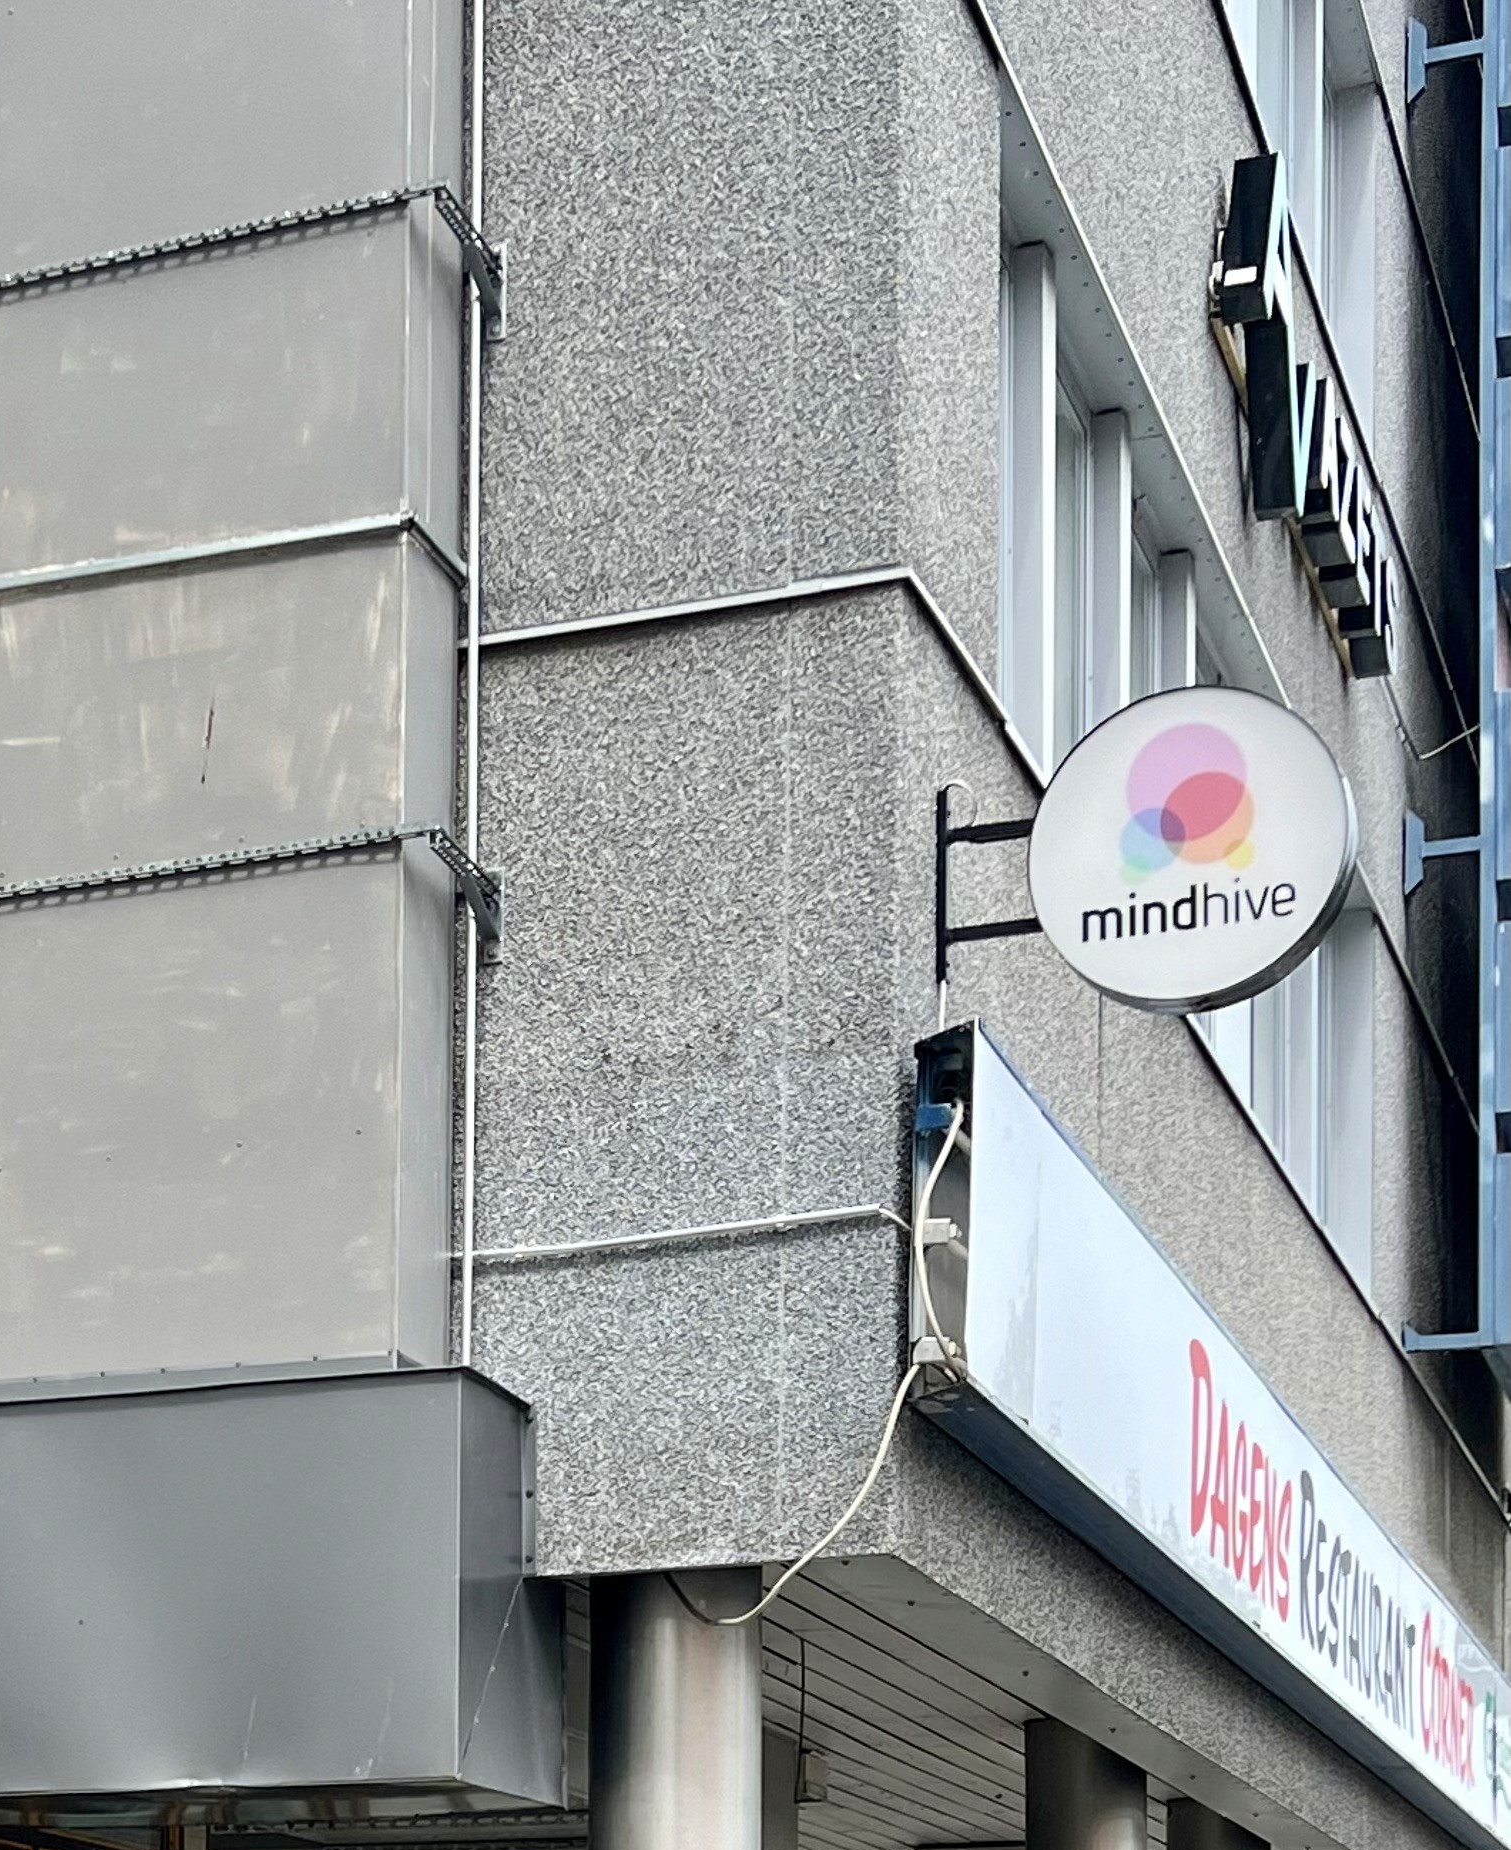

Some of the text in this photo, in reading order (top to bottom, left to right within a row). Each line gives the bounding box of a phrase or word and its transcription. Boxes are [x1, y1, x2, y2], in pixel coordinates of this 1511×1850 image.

[1082, 877, 1296, 943] mindhive
[1190, 1339, 1475, 1791] DAGENS RESTAURANT CORNER
